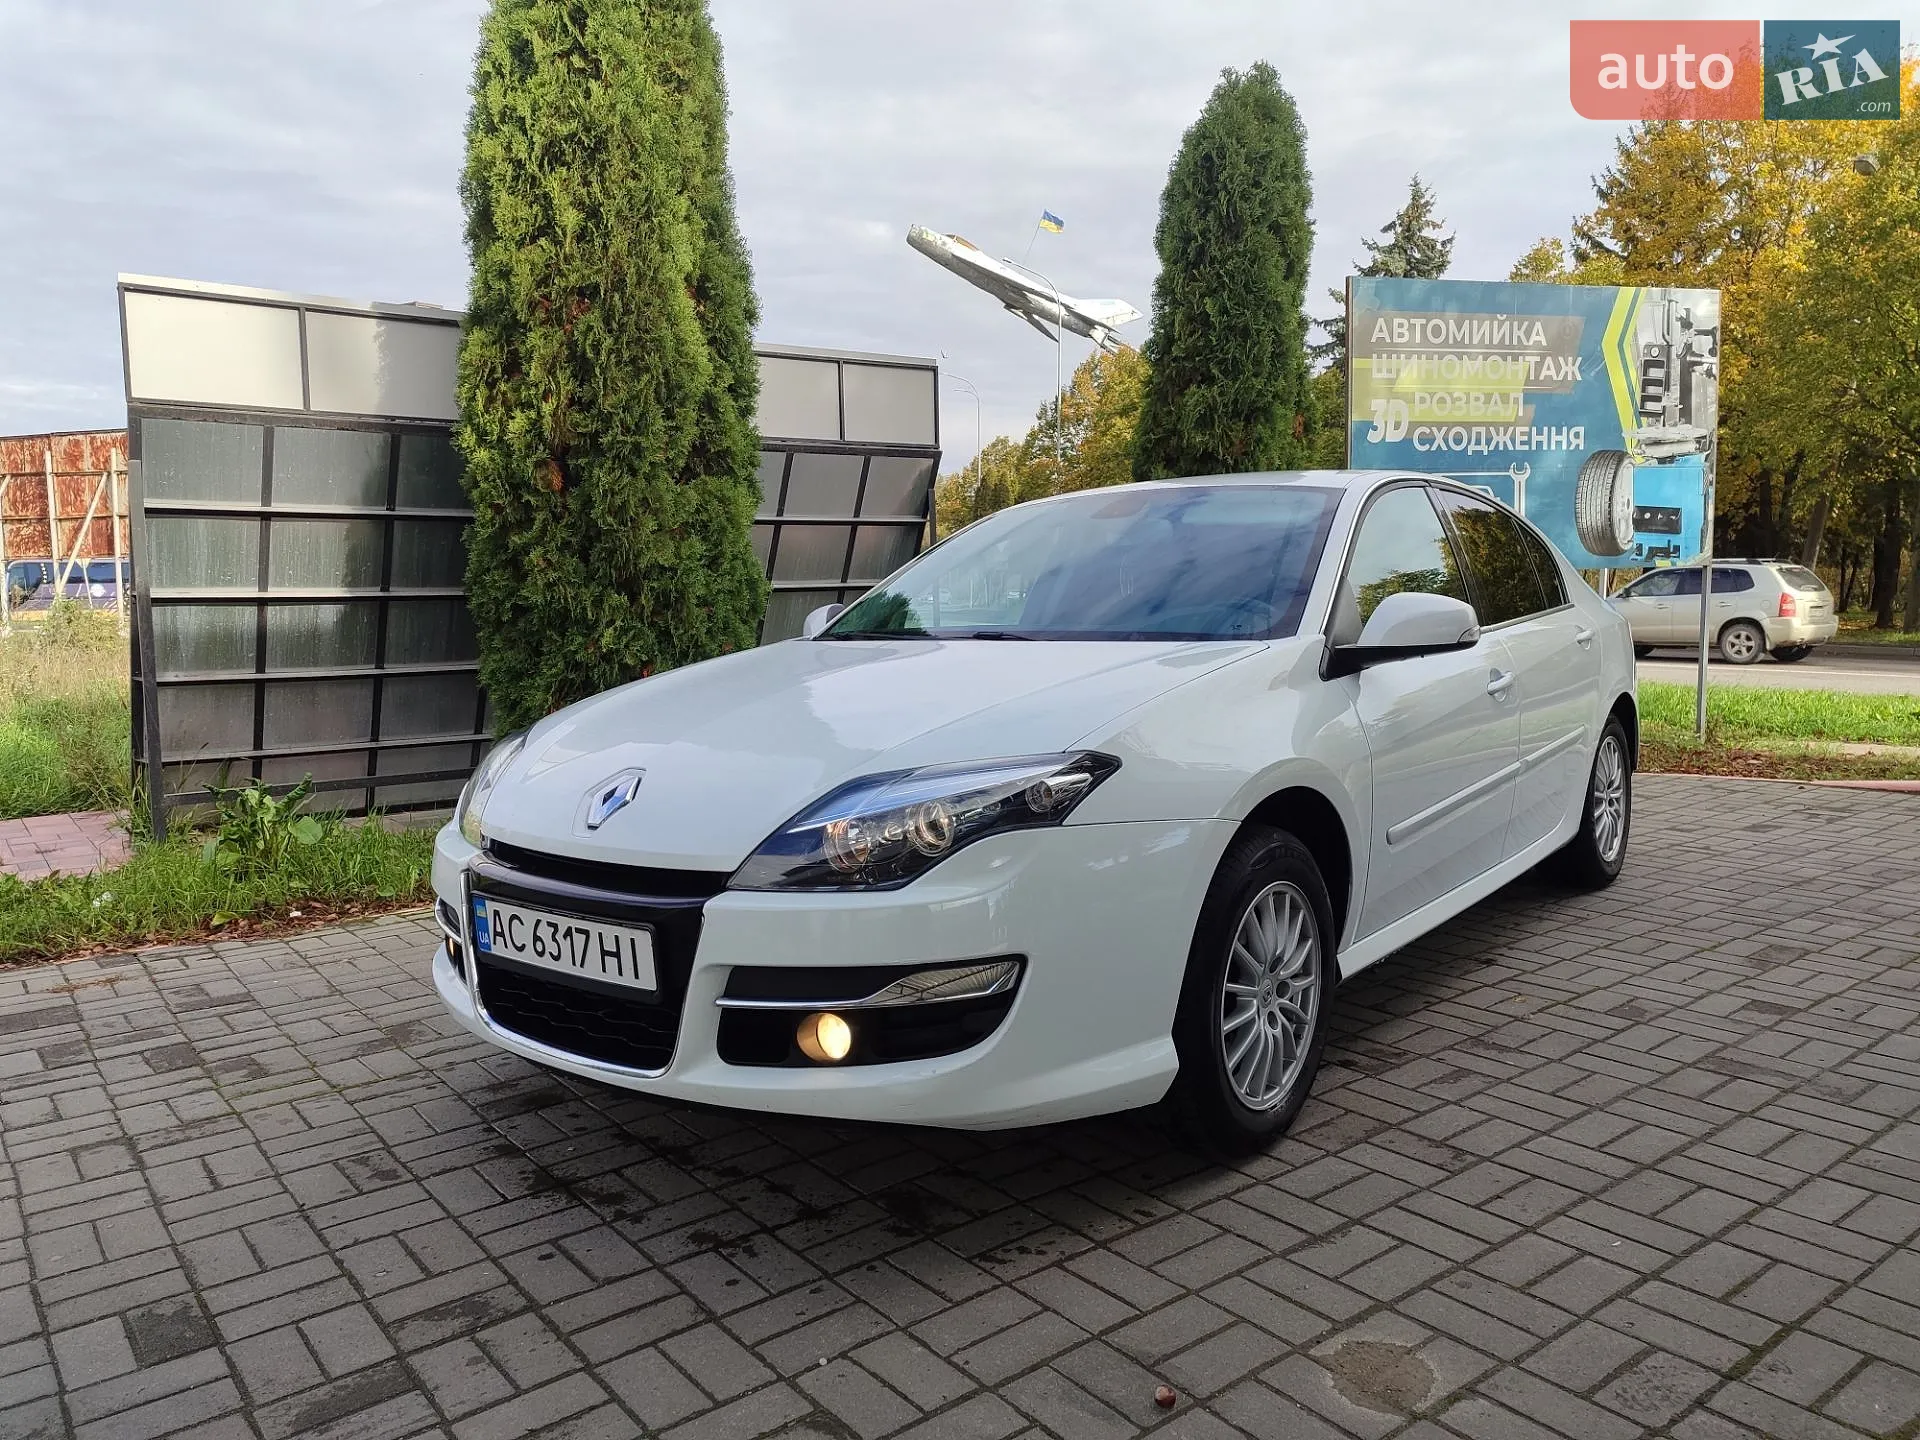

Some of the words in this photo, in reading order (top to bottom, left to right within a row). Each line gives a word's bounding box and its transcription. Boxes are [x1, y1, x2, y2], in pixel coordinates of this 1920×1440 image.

[1370, 313, 1548, 347] АВТОМИЙКА
[1371, 353, 1583, 382] ШИНОМОНТАЖ
[1413, 391, 1525, 418] РОЗВАЛ
[1367, 398, 1409, 444] 3D
[1412, 425, 1585, 456] СХОДЖЕННЯ
[478, 930, 490, 945] UA
[492, 909, 526, 952] AC
[532, 918, 591, 969] 6317
[597, 931, 640, 980] HI
